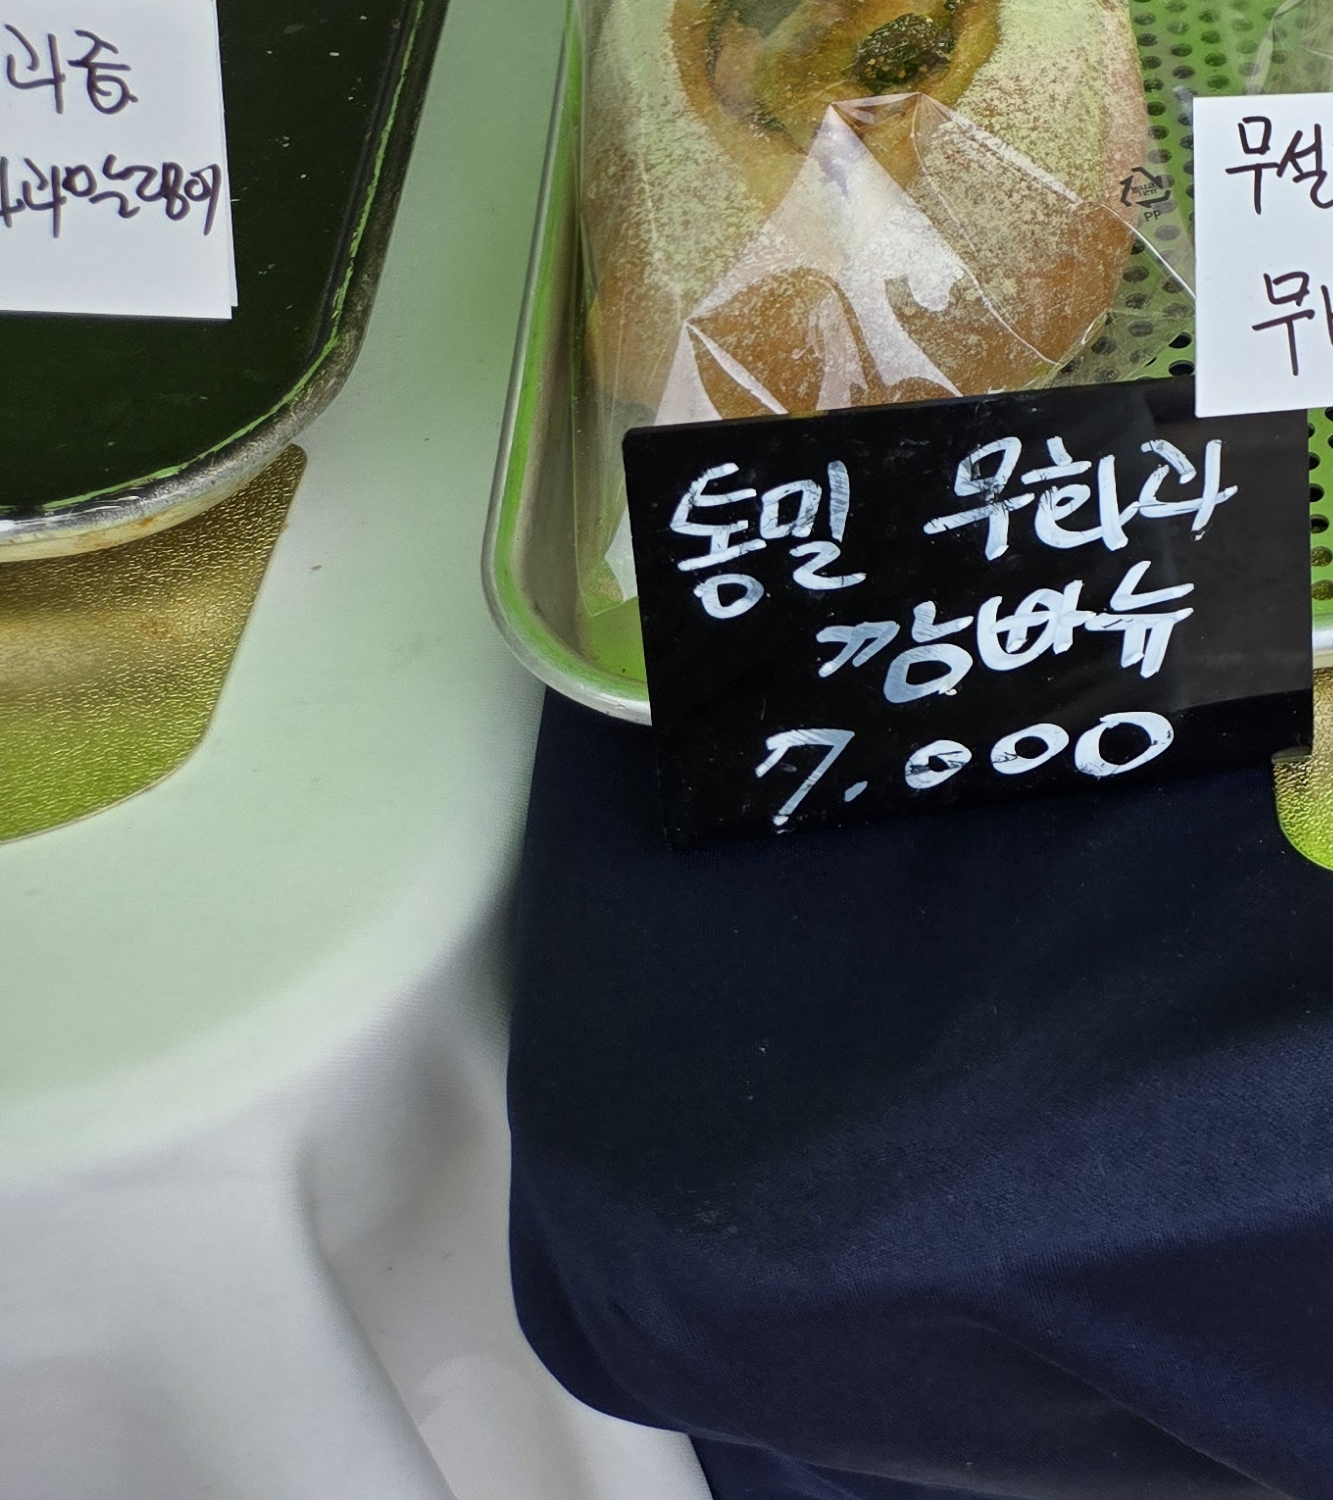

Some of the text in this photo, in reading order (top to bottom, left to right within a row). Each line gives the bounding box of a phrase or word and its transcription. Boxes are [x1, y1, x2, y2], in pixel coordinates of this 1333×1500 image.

[1143, 209, 1162, 222] PP
[923, 435, 1238, 561] 무화과
[754, 710, 1175, 829] 7.000
